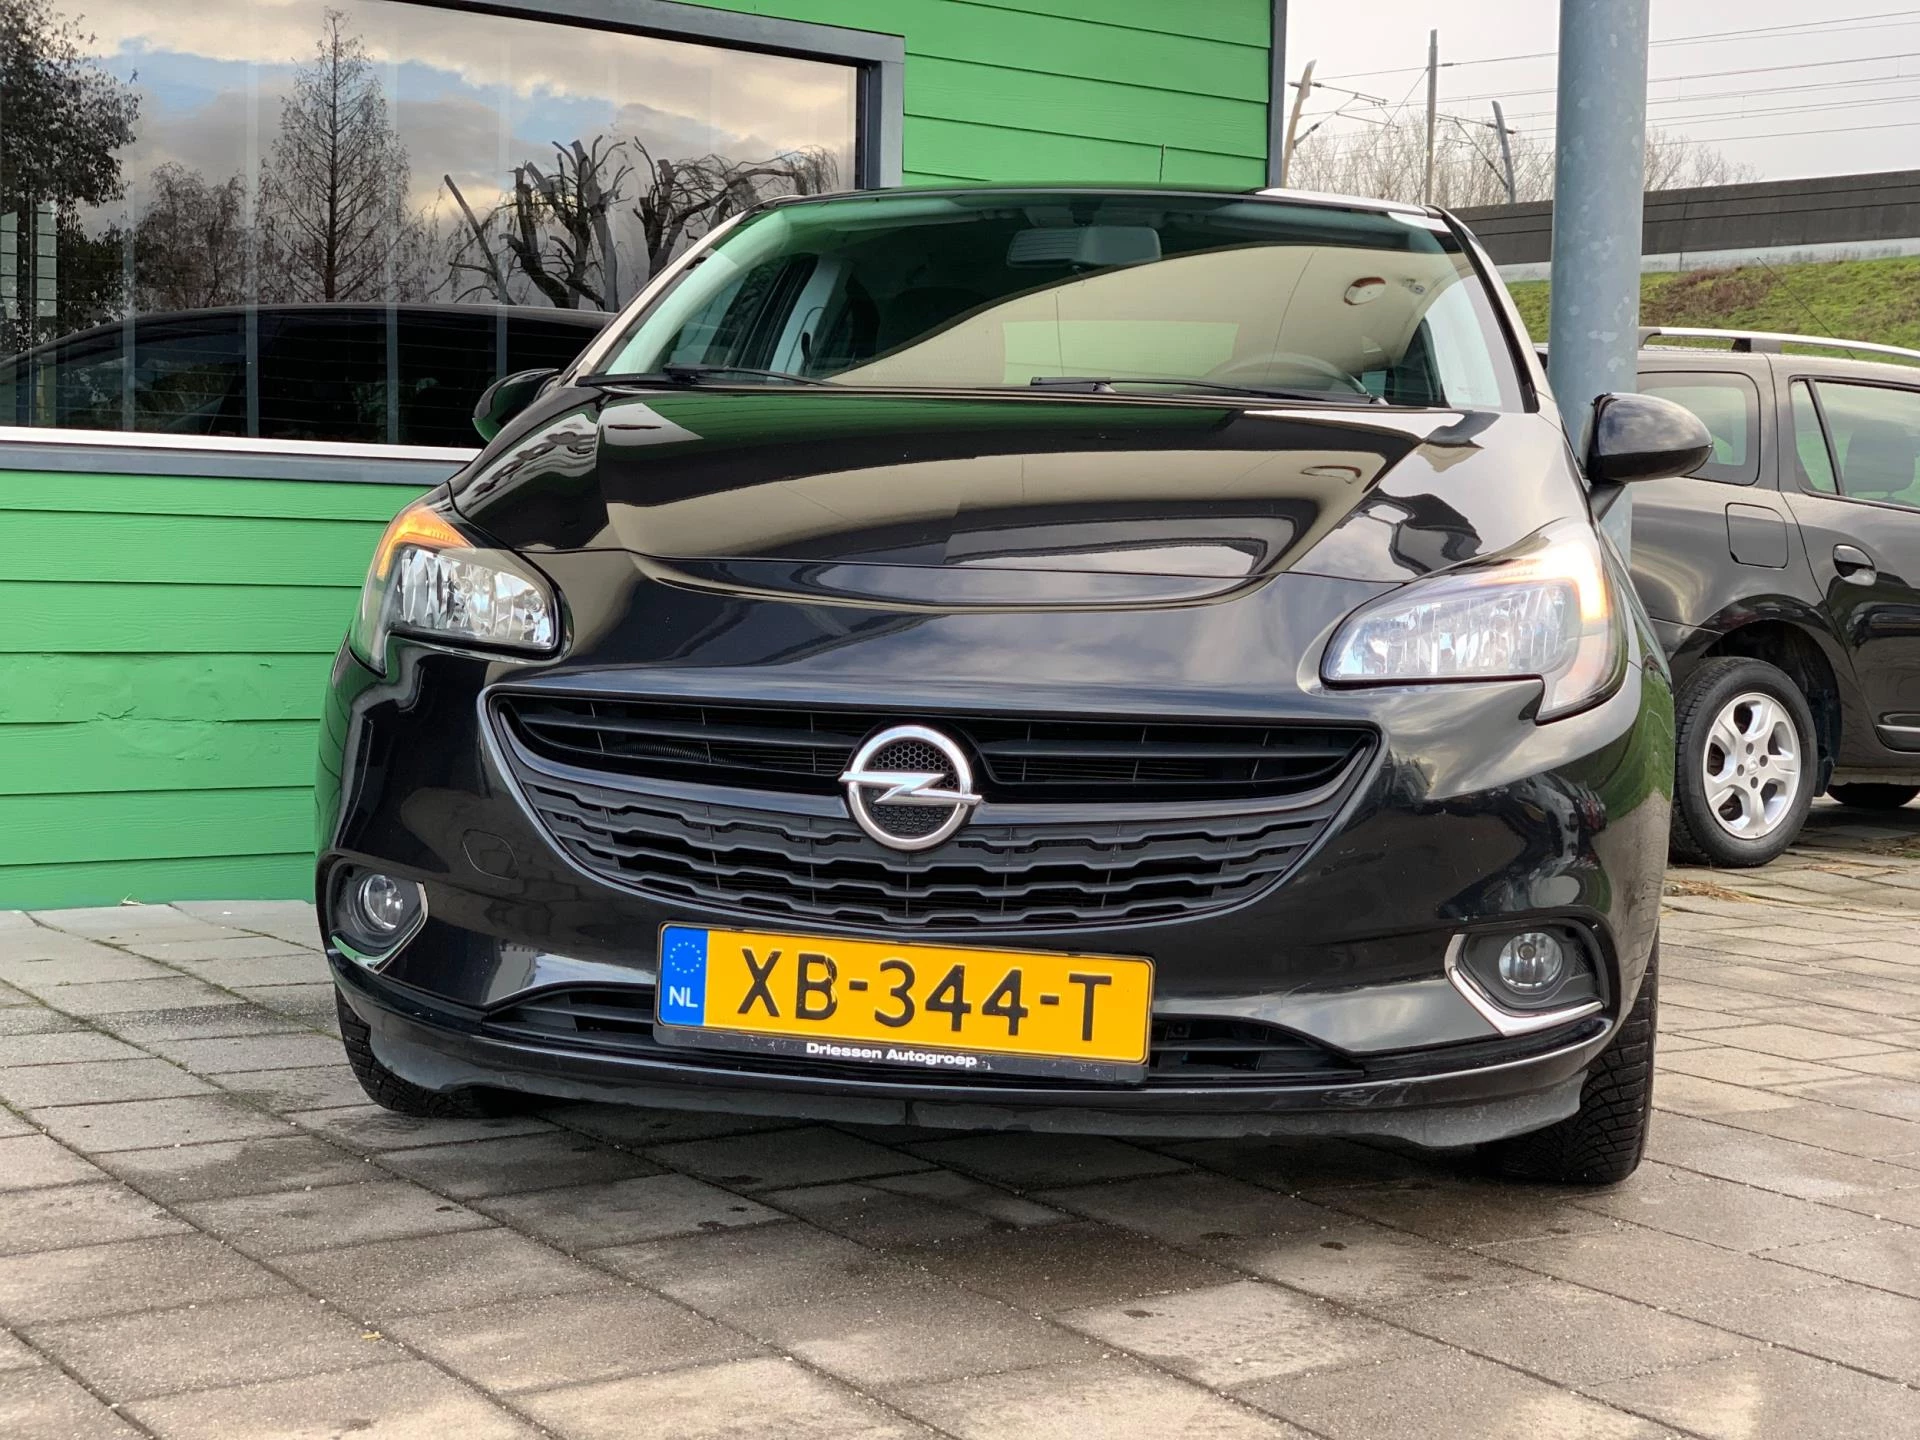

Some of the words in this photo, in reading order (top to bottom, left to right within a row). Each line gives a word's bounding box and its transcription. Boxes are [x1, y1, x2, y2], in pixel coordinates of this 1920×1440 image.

[669, 985, 698, 1008] NL
[737, 948, 1112, 1042] XB-344-T
[806, 1042, 882, 1059] Driessen
[886, 1049, 977, 1068] Autogroep
